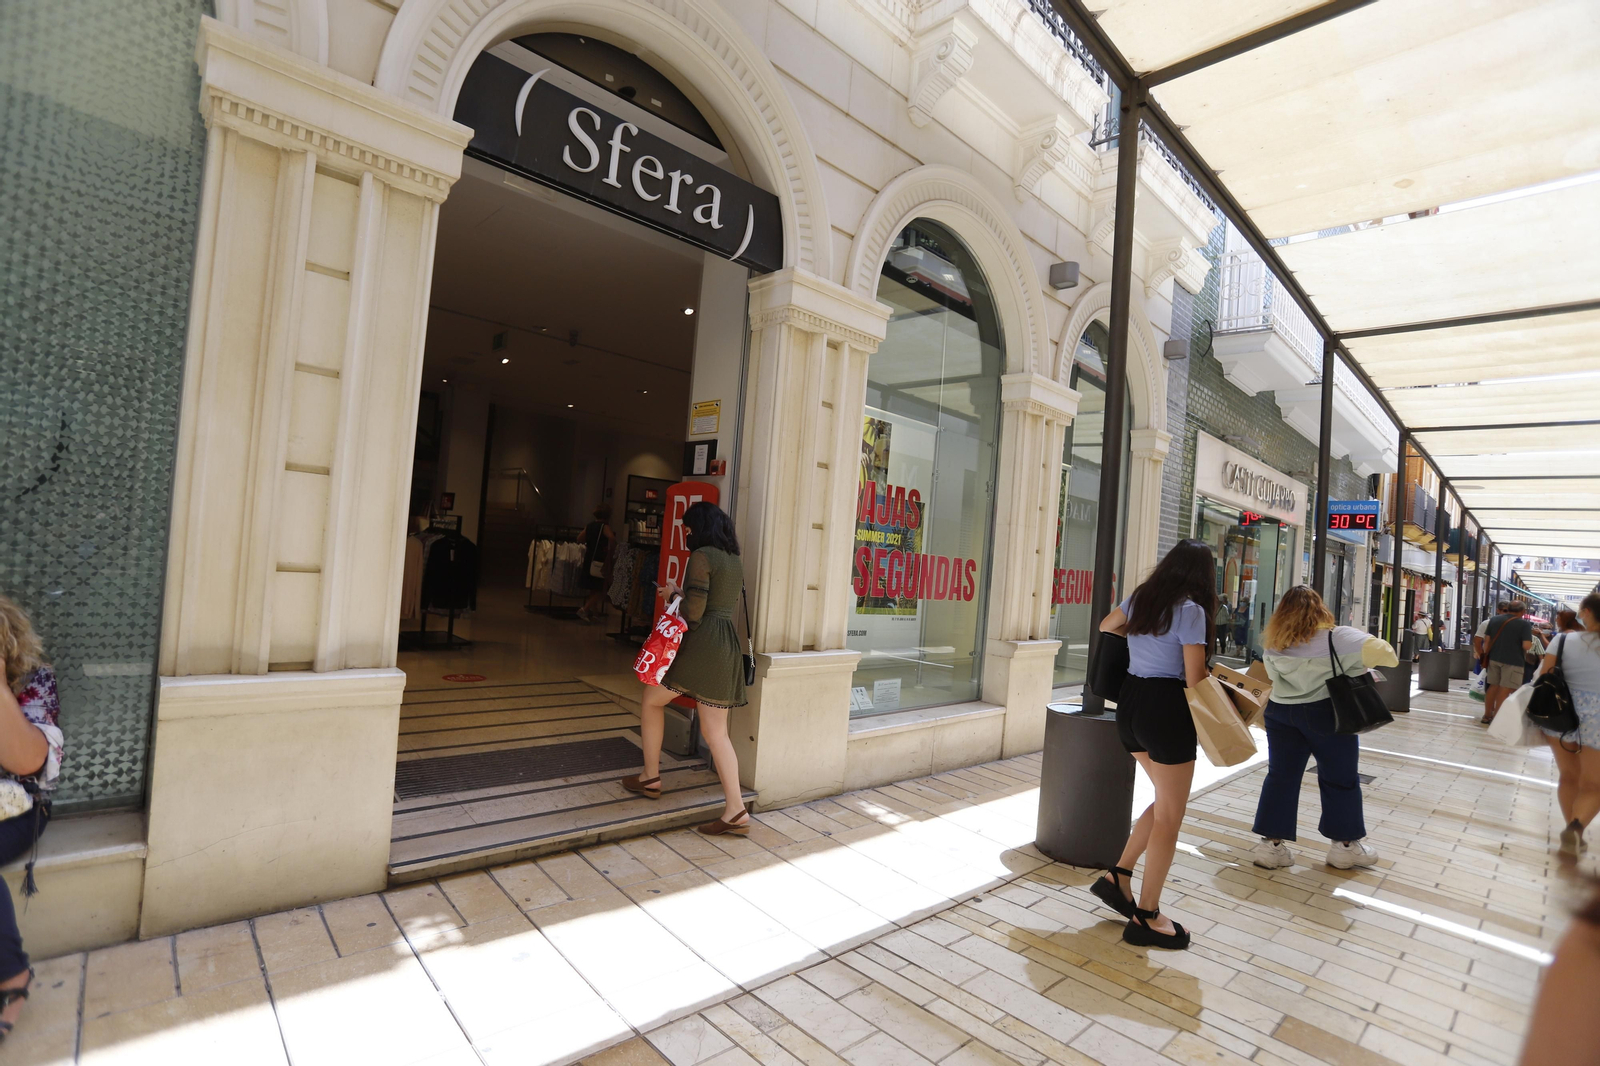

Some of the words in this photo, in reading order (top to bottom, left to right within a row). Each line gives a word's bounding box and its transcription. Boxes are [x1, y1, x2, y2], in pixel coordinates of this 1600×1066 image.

[856, 480, 921, 530] AJAS
[1353, 503, 1376, 511] urbano
[1330, 514, 1350, 529] 30
[886, 532, 901, 545] 2021
[853, 546, 977, 602] SEGUNDAS
